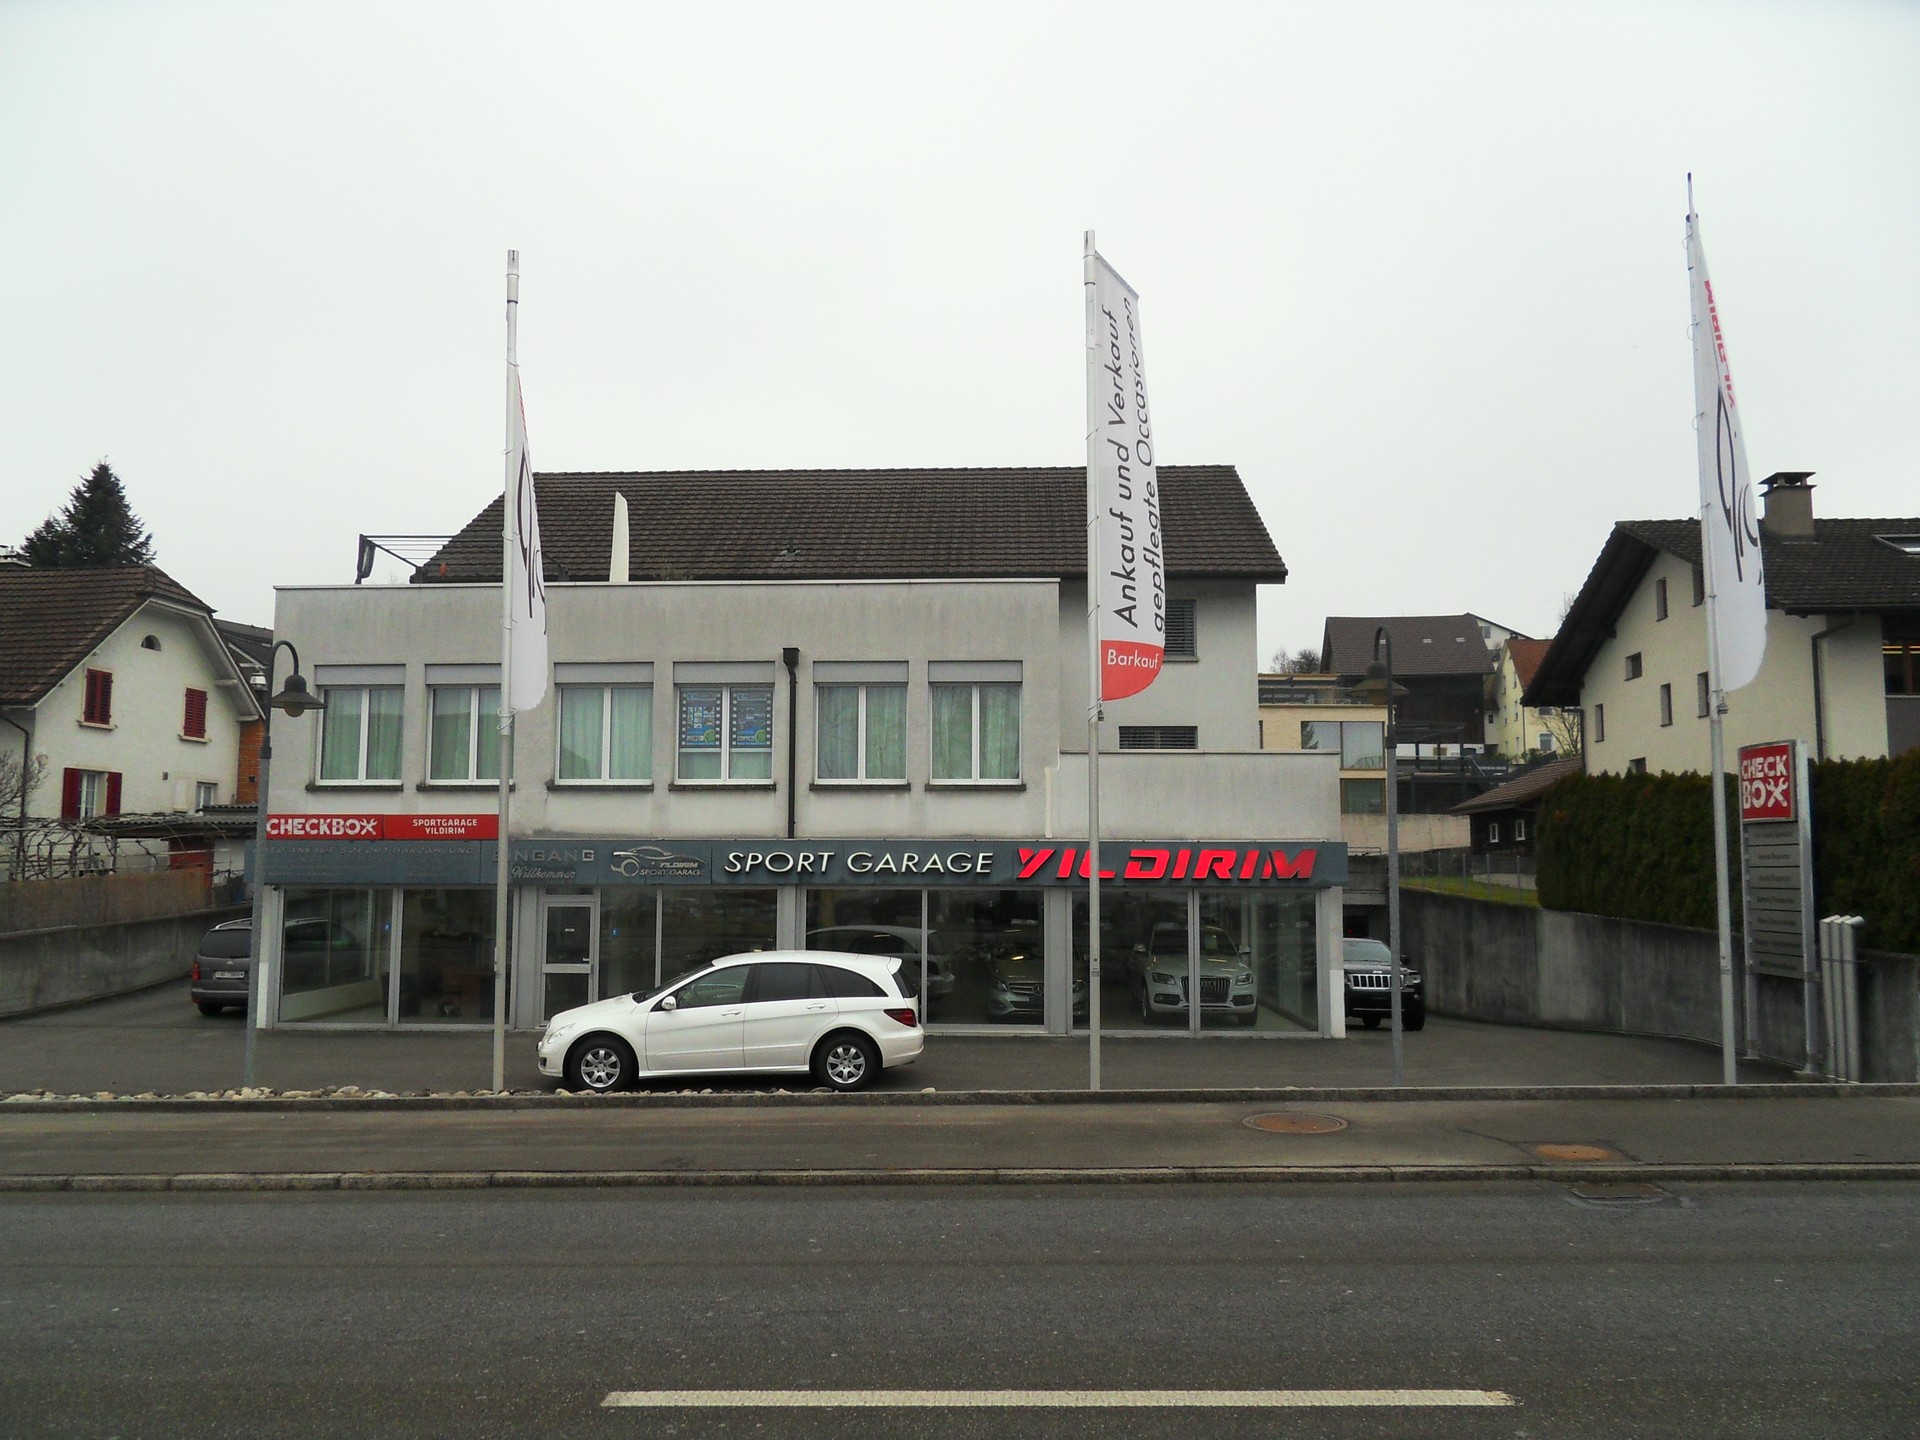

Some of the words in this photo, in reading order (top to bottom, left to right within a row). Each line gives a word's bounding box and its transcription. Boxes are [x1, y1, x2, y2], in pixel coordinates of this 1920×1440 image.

[1102, 304, 1127, 425] Verkauf
[1124, 297, 1152, 467] Occasionen
[1107, 437, 1133, 501] und
[1109, 507, 1138, 628] Ankauf
[1143, 480, 1165, 634] gepflegte
[1107, 649, 1159, 669] Barkauf
[1741, 755, 1788, 779] CHECK
[1743, 778, 1789, 809] BOX
[266, 818, 378, 836] CHECKBOX
[412, 818, 478, 827] SPORTGARAGE
[425, 827, 465, 835] YILDIRIM
[512, 865, 576, 880] Willkommen
[640, 868, 669, 876] SPORT
[724, 851, 836, 874] SPORT
[846, 851, 994, 874] GARAGE
[1017, 848, 1319, 880] YILDIRIM
